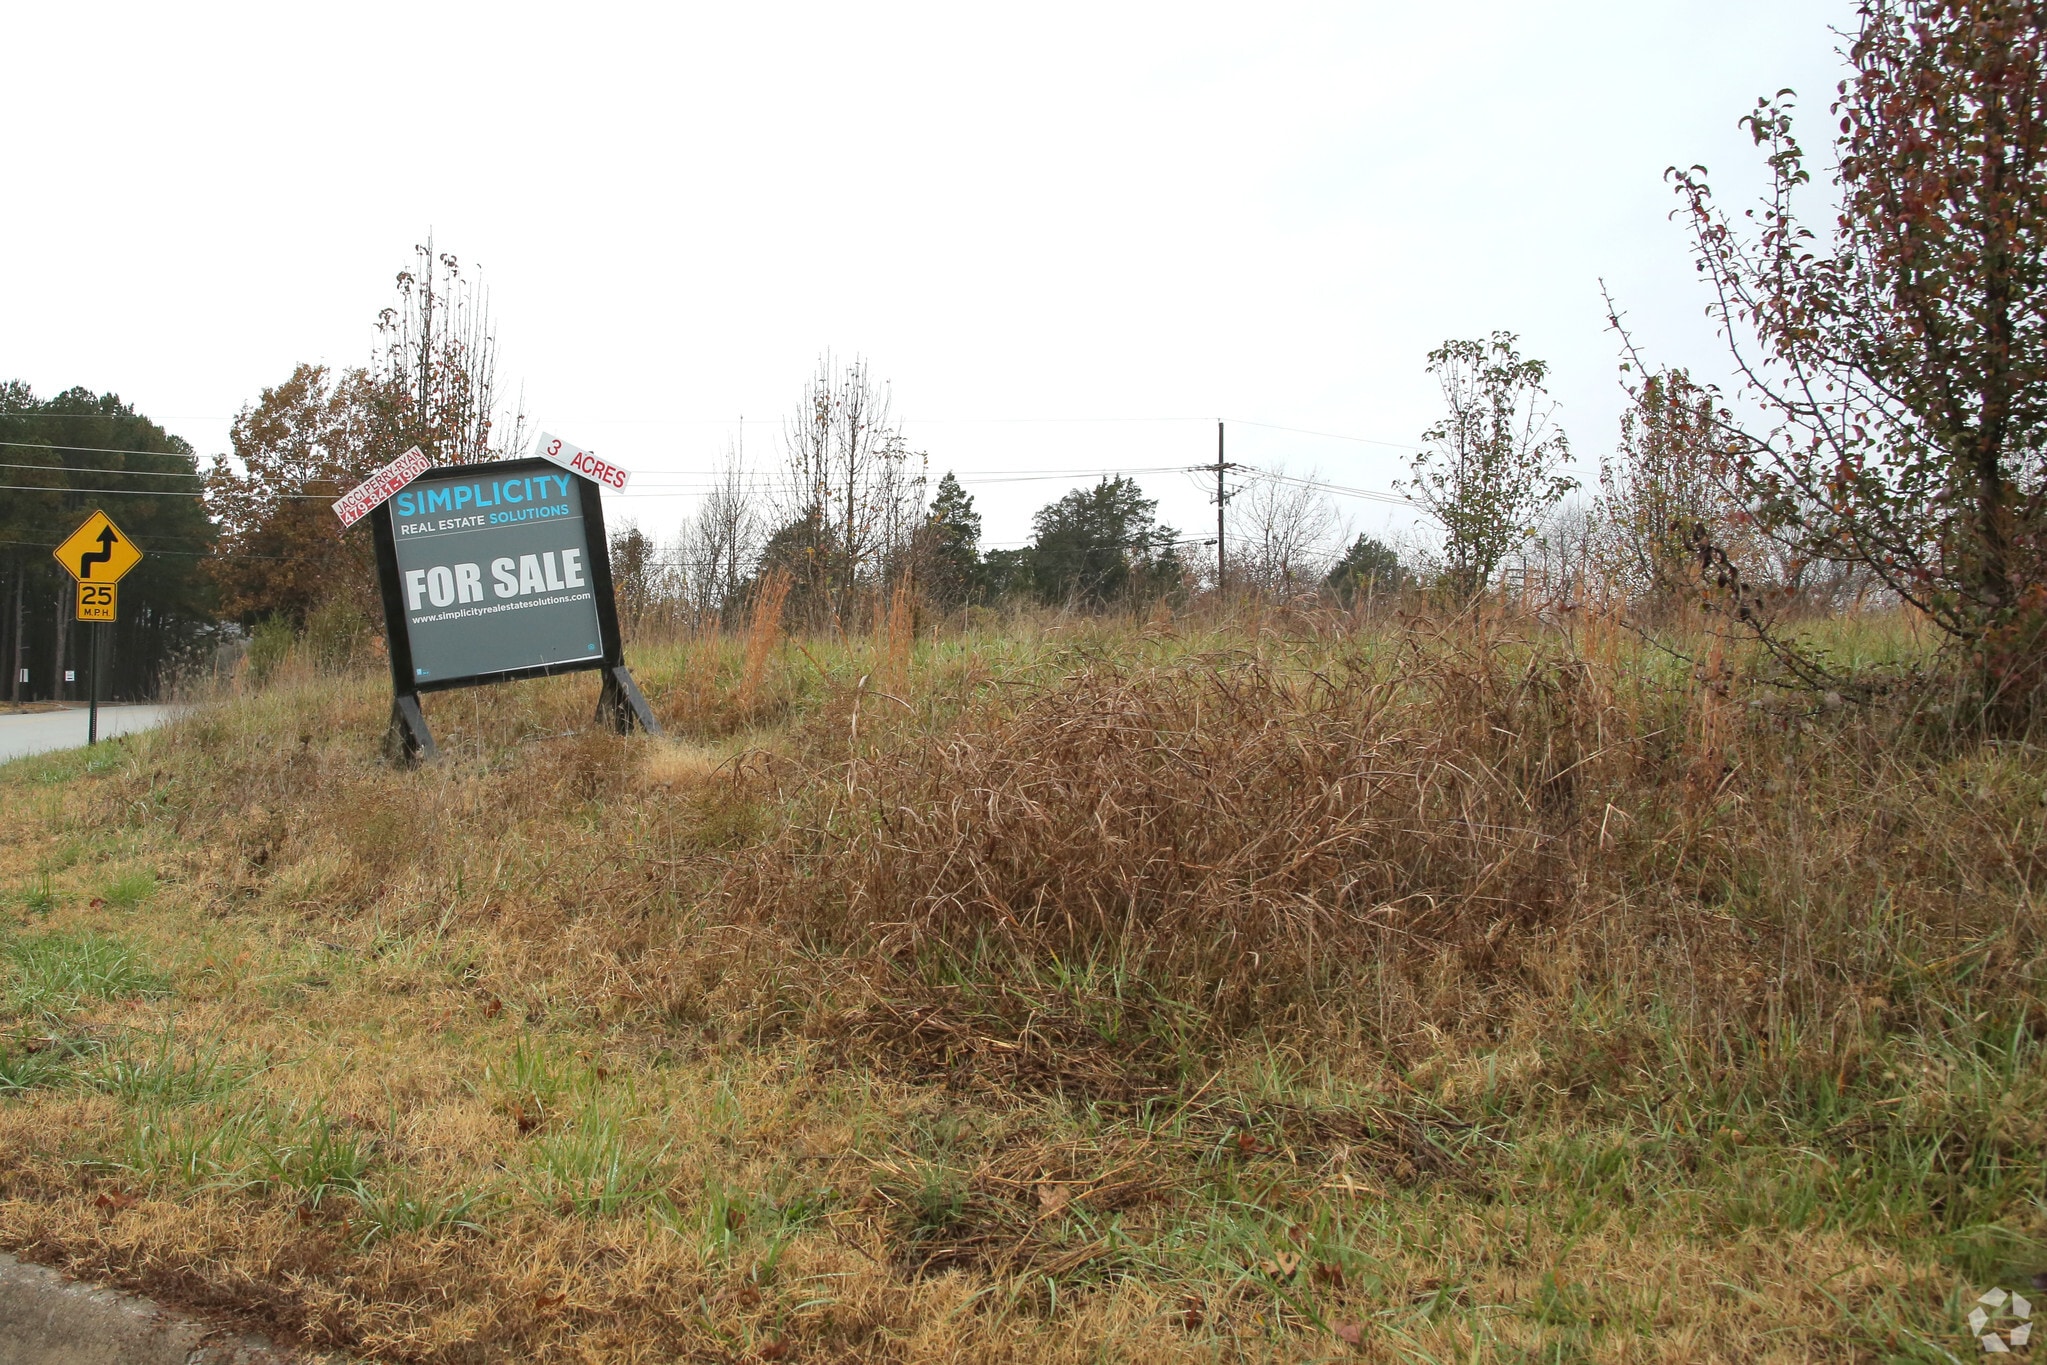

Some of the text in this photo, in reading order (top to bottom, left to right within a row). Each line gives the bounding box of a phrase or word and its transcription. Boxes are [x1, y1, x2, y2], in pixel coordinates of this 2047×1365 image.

[337, 449, 420, 514] JACCI PERRY-RYAN
[547, 439, 626, 489] 3 ACRES
[344, 460, 428, 524] 479-841-1900
[397, 473, 571, 517] SIMPLICITY
[401, 504, 569, 535] REAL ESTATE SOLUTIONS
[82, 586, 112, 605] 25
[405, 548, 585, 611] FOR SALE
[412, 594, 591, 625] www.simplicityrealestatesolutions.com
